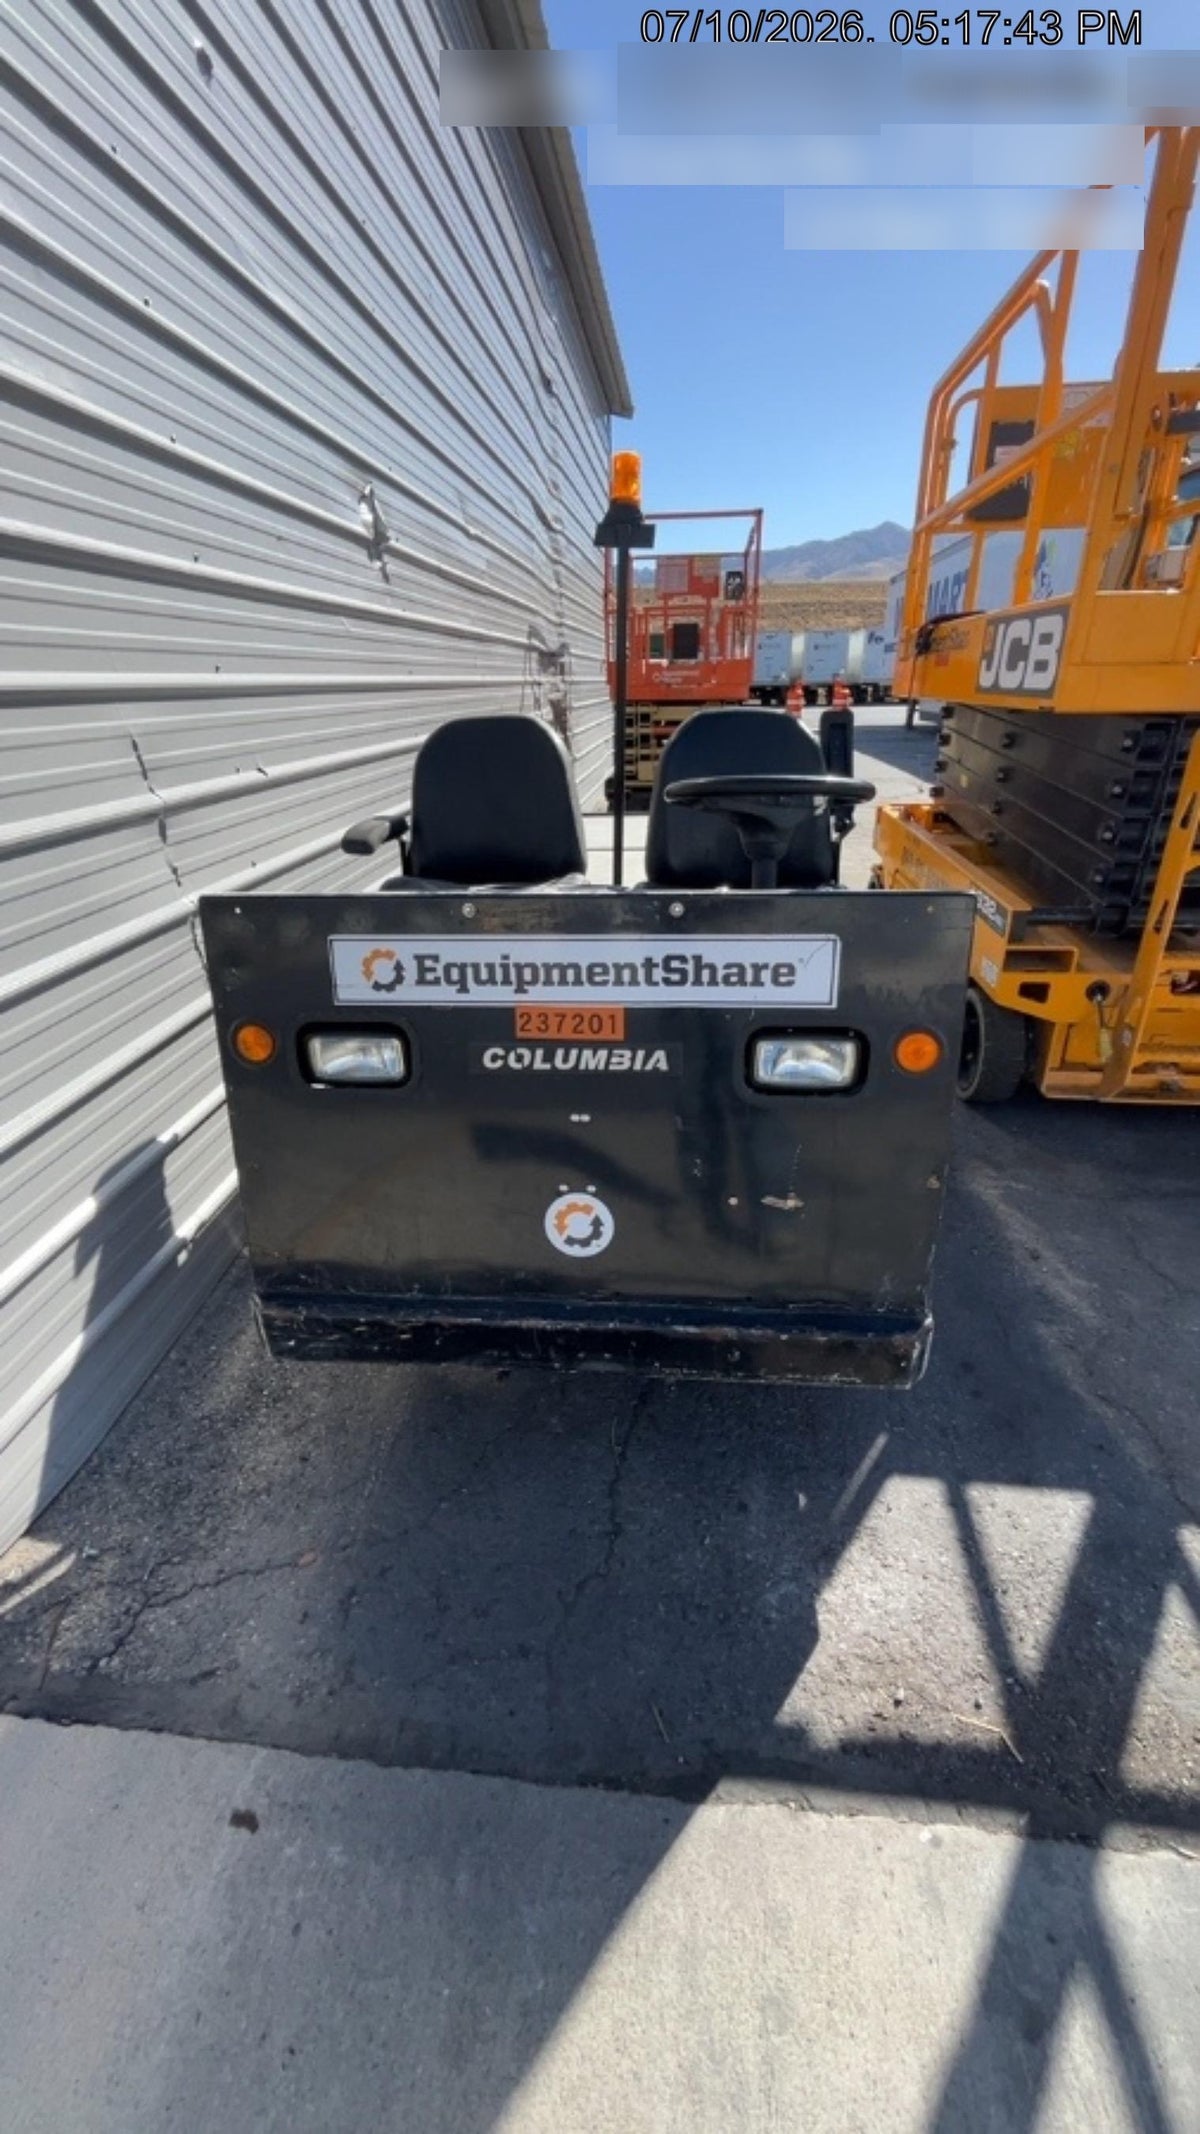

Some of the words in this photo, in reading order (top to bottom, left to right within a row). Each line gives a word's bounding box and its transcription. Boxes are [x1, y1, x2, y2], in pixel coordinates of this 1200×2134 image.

[979, 613, 1064, 691] JCB
[413, 953, 797, 994] EquipmentShare
[518, 1010, 620, 1036] 237201
[482, 1048, 670, 1072] COLUMBIA
